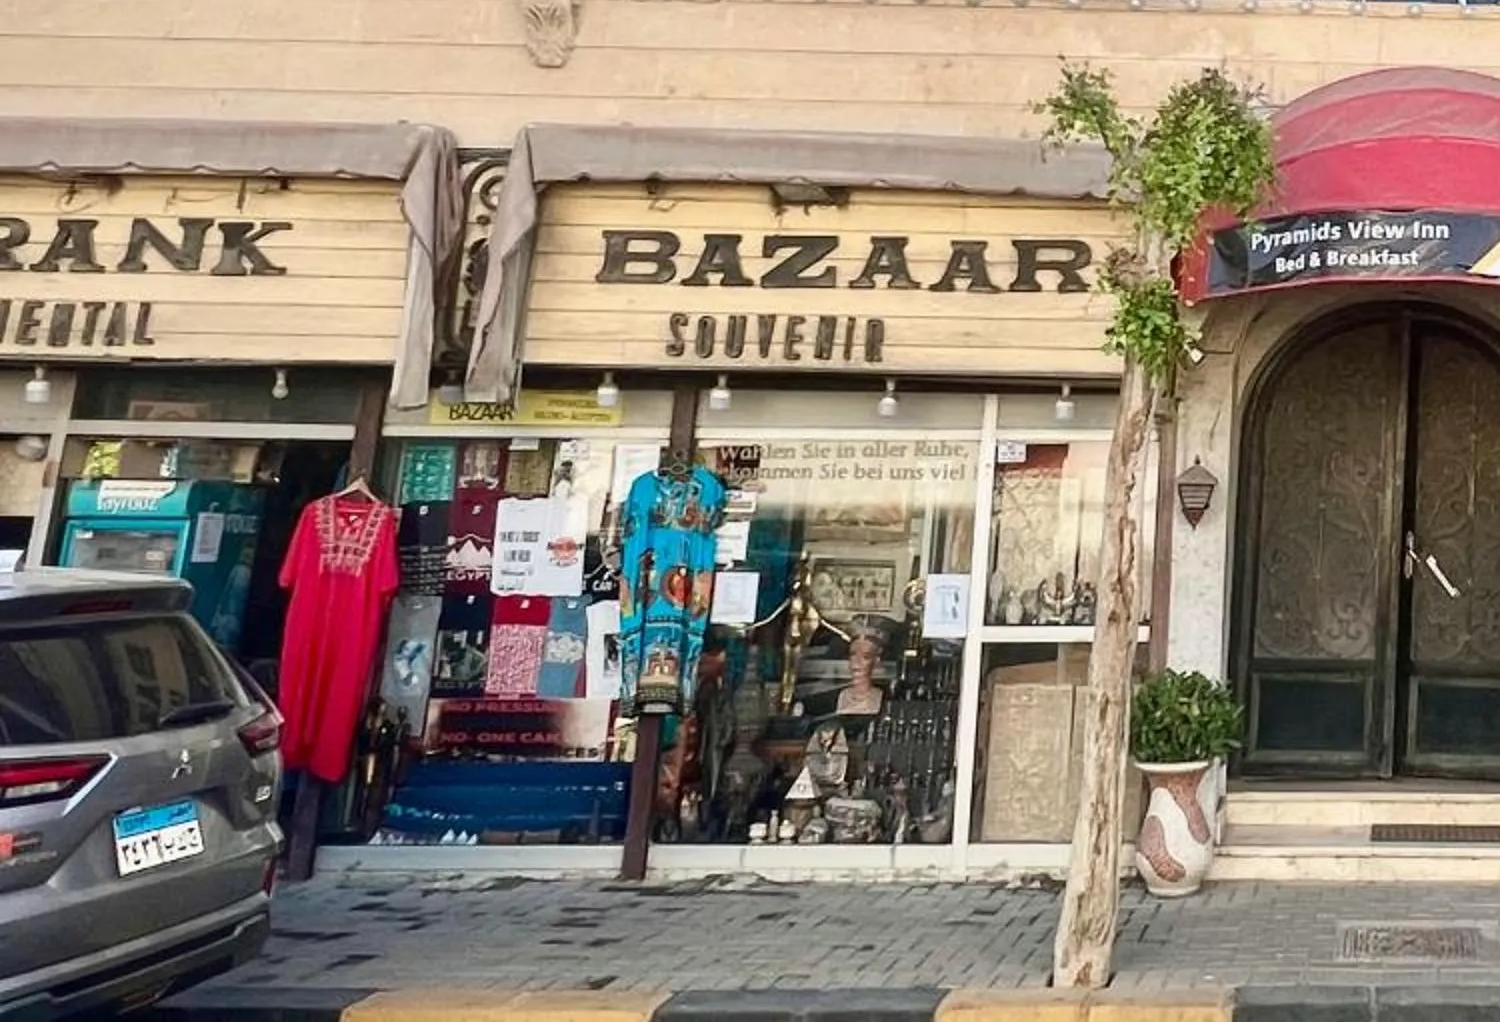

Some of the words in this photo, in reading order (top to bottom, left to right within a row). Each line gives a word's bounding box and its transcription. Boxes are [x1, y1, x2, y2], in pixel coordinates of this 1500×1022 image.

[1251, 221, 1342, 253] Pyramids
[1347, 219, 1406, 240] View
[1412, 220, 1450, 239] Inn
[595, 228, 1093, 294] BAZAAR
[1275, 255, 1305, 273] Bed
[1309, 251, 1321, 268] &
[1326, 250, 1419, 267] Breakfast
[665, 311, 885, 363] SOUVENIR
[802, 443, 831, 460] Sie
[836, 442, 856, 459] in
[861, 441, 908, 459] aller
[913, 440, 969, 461] Ruhe,
[818, 463, 848, 479] Sie
[853, 463, 884, 481] bei
[889, 465, 925, 479] uns
[929, 463, 966, 479] viel
